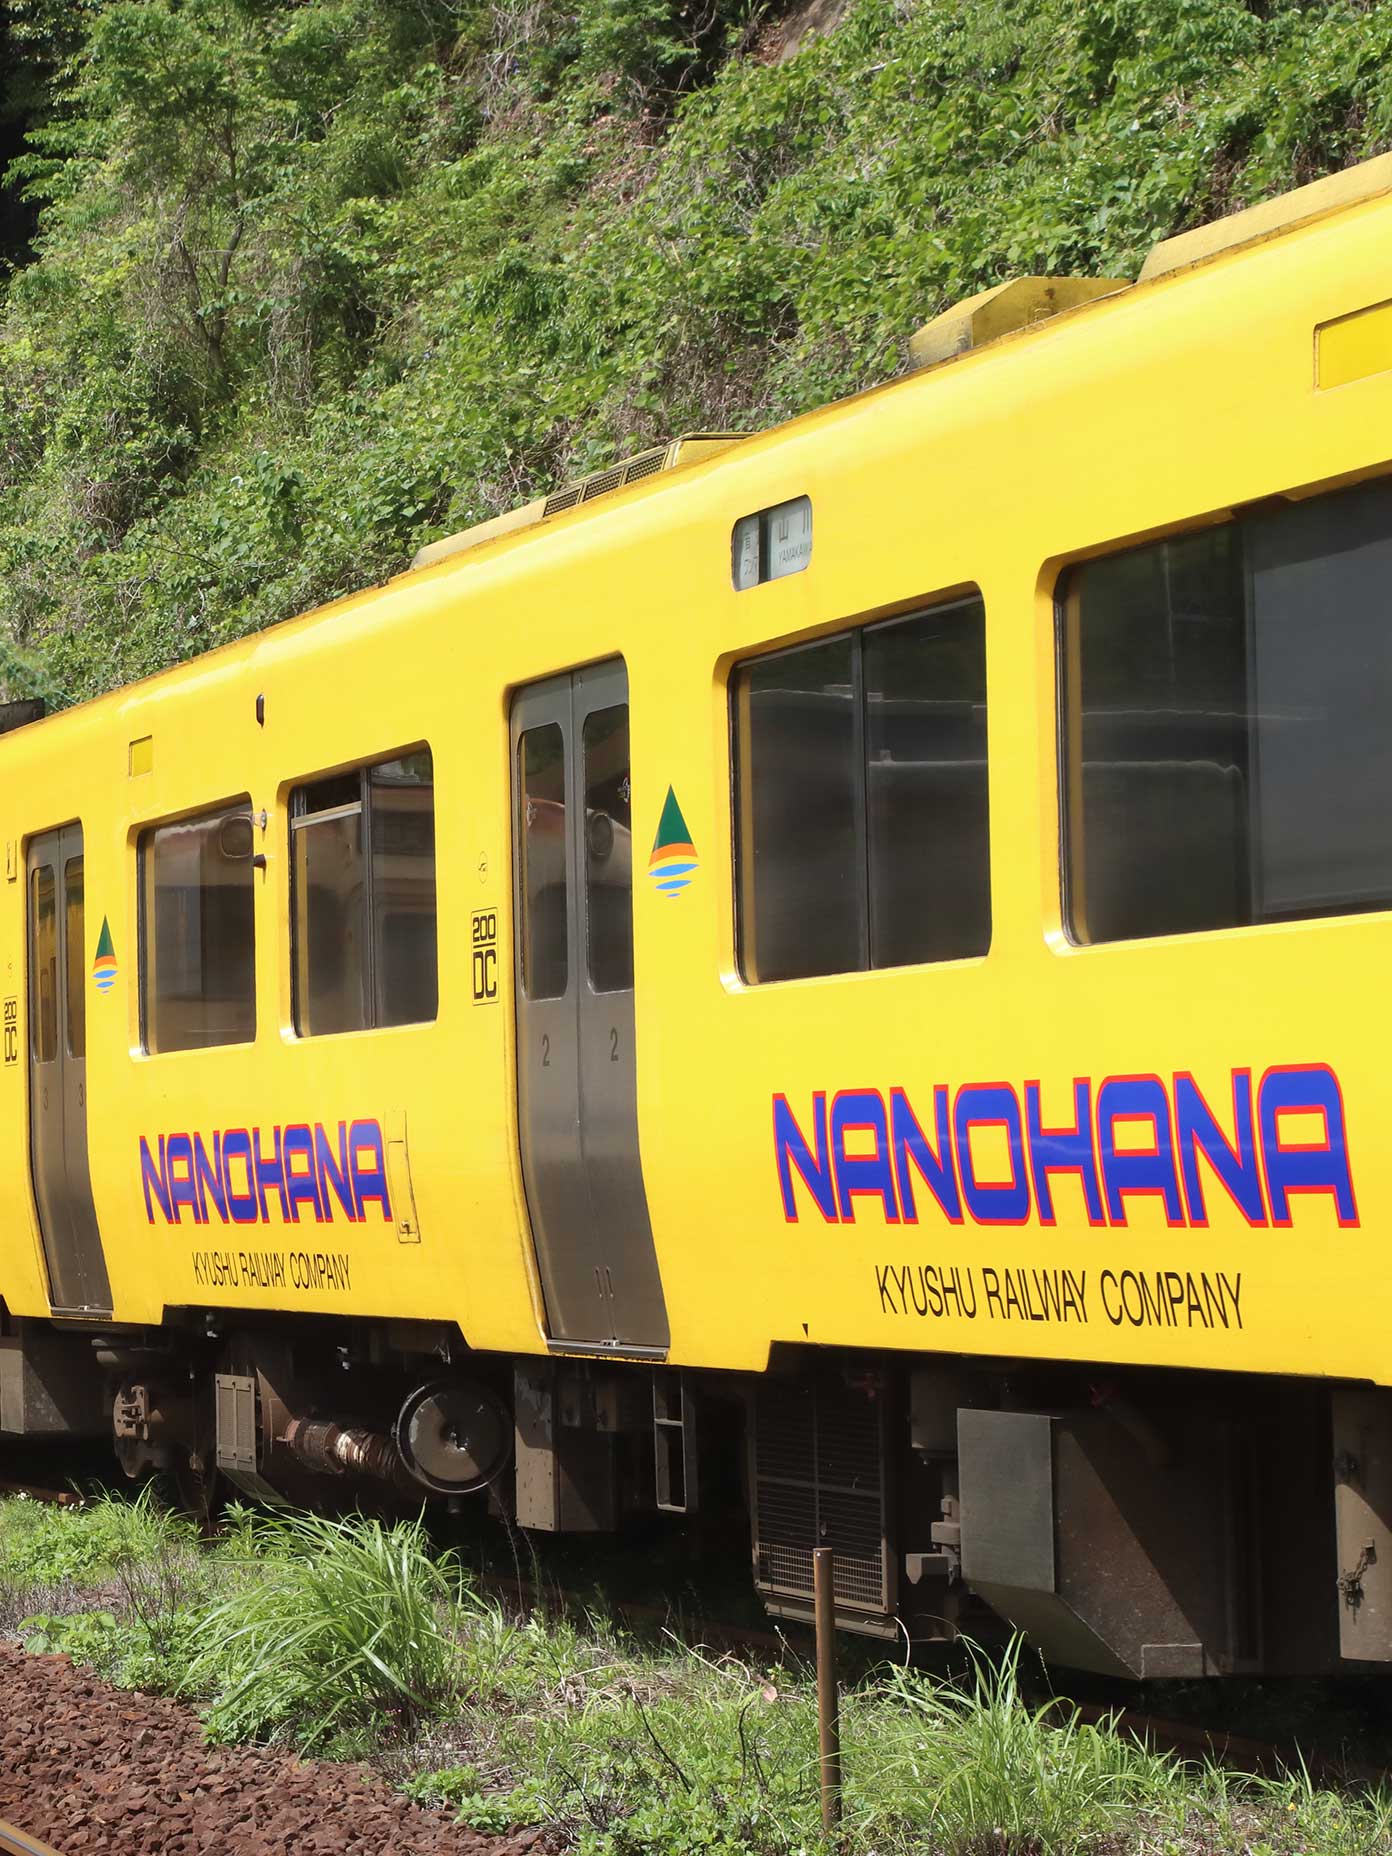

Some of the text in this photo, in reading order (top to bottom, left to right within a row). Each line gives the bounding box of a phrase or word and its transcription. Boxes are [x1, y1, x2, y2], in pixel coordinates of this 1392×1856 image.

[472, 914, 497, 942] 200
[473, 949, 497, 1000] DC
[542, 1034, 550, 1066] 2
[610, 1027, 619, 1061] 2
[772, 1062, 1361, 1228] NANOHANA
[139, 1119, 393, 1224] NANOHANA
[192, 1252, 351, 1290] KYUSHU RAILWAY COMPANY
[875, 1265, 1243, 1329] KYUSHU RAILWAY COMPANY
